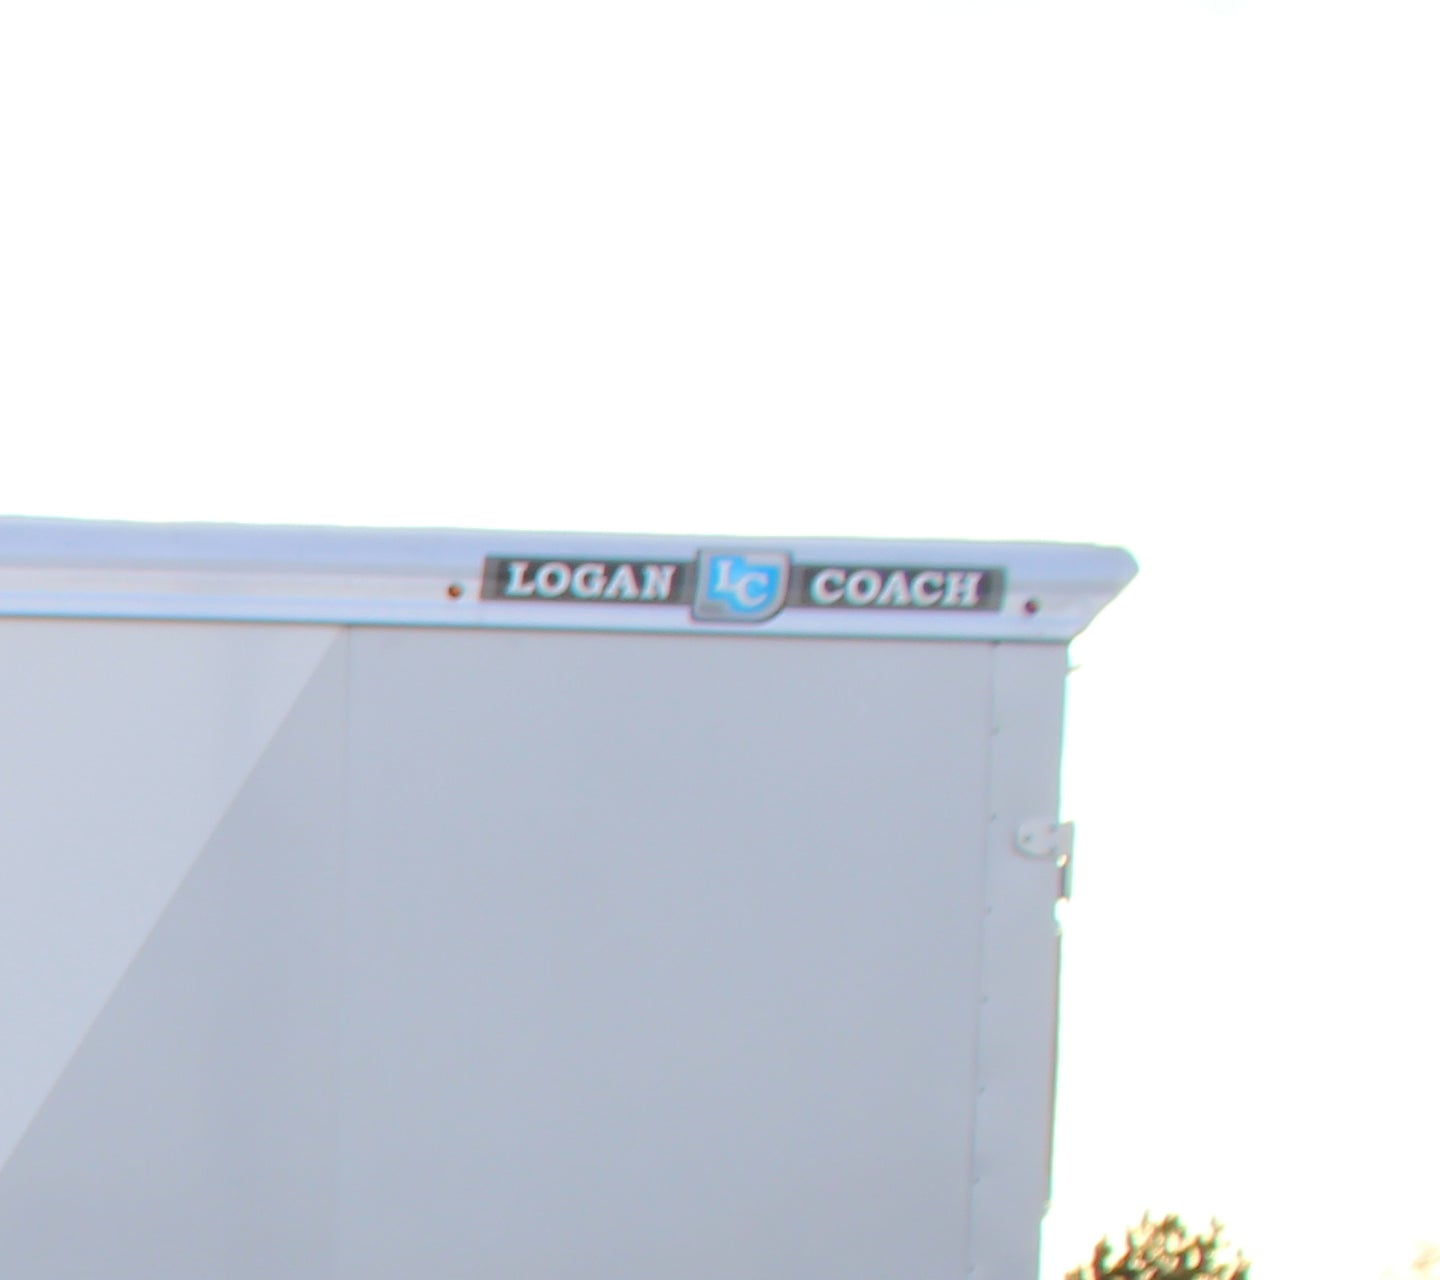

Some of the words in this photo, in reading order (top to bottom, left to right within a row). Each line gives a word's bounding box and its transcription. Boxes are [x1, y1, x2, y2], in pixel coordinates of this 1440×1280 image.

[504, 560, 676, 601] LOGAN
[712, 559, 771, 603] LC
[807, 568, 984, 608] COACH
